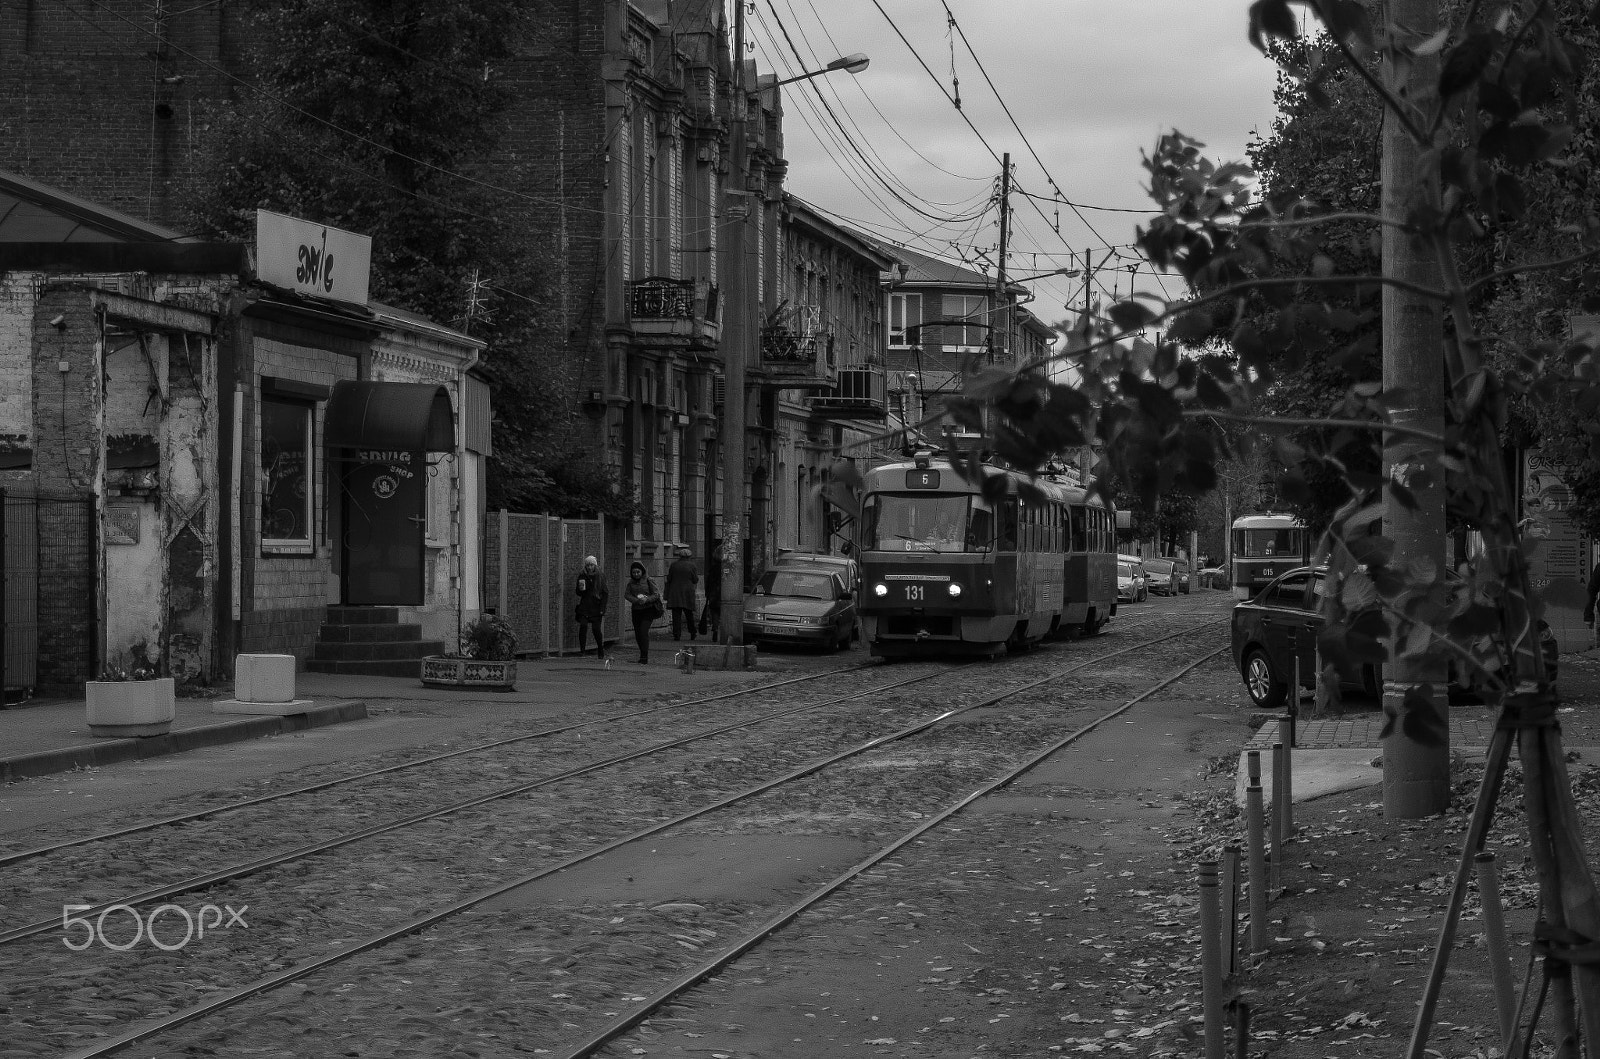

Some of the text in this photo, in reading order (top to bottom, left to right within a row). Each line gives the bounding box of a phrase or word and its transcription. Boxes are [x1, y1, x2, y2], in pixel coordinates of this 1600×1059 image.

[390, 465, 414, 478] SHOP
[922, 473, 928, 485] 6
[905, 540, 911, 551] 6
[1263, 568, 1274, 576] 015
[904, 585, 924, 600] 131
